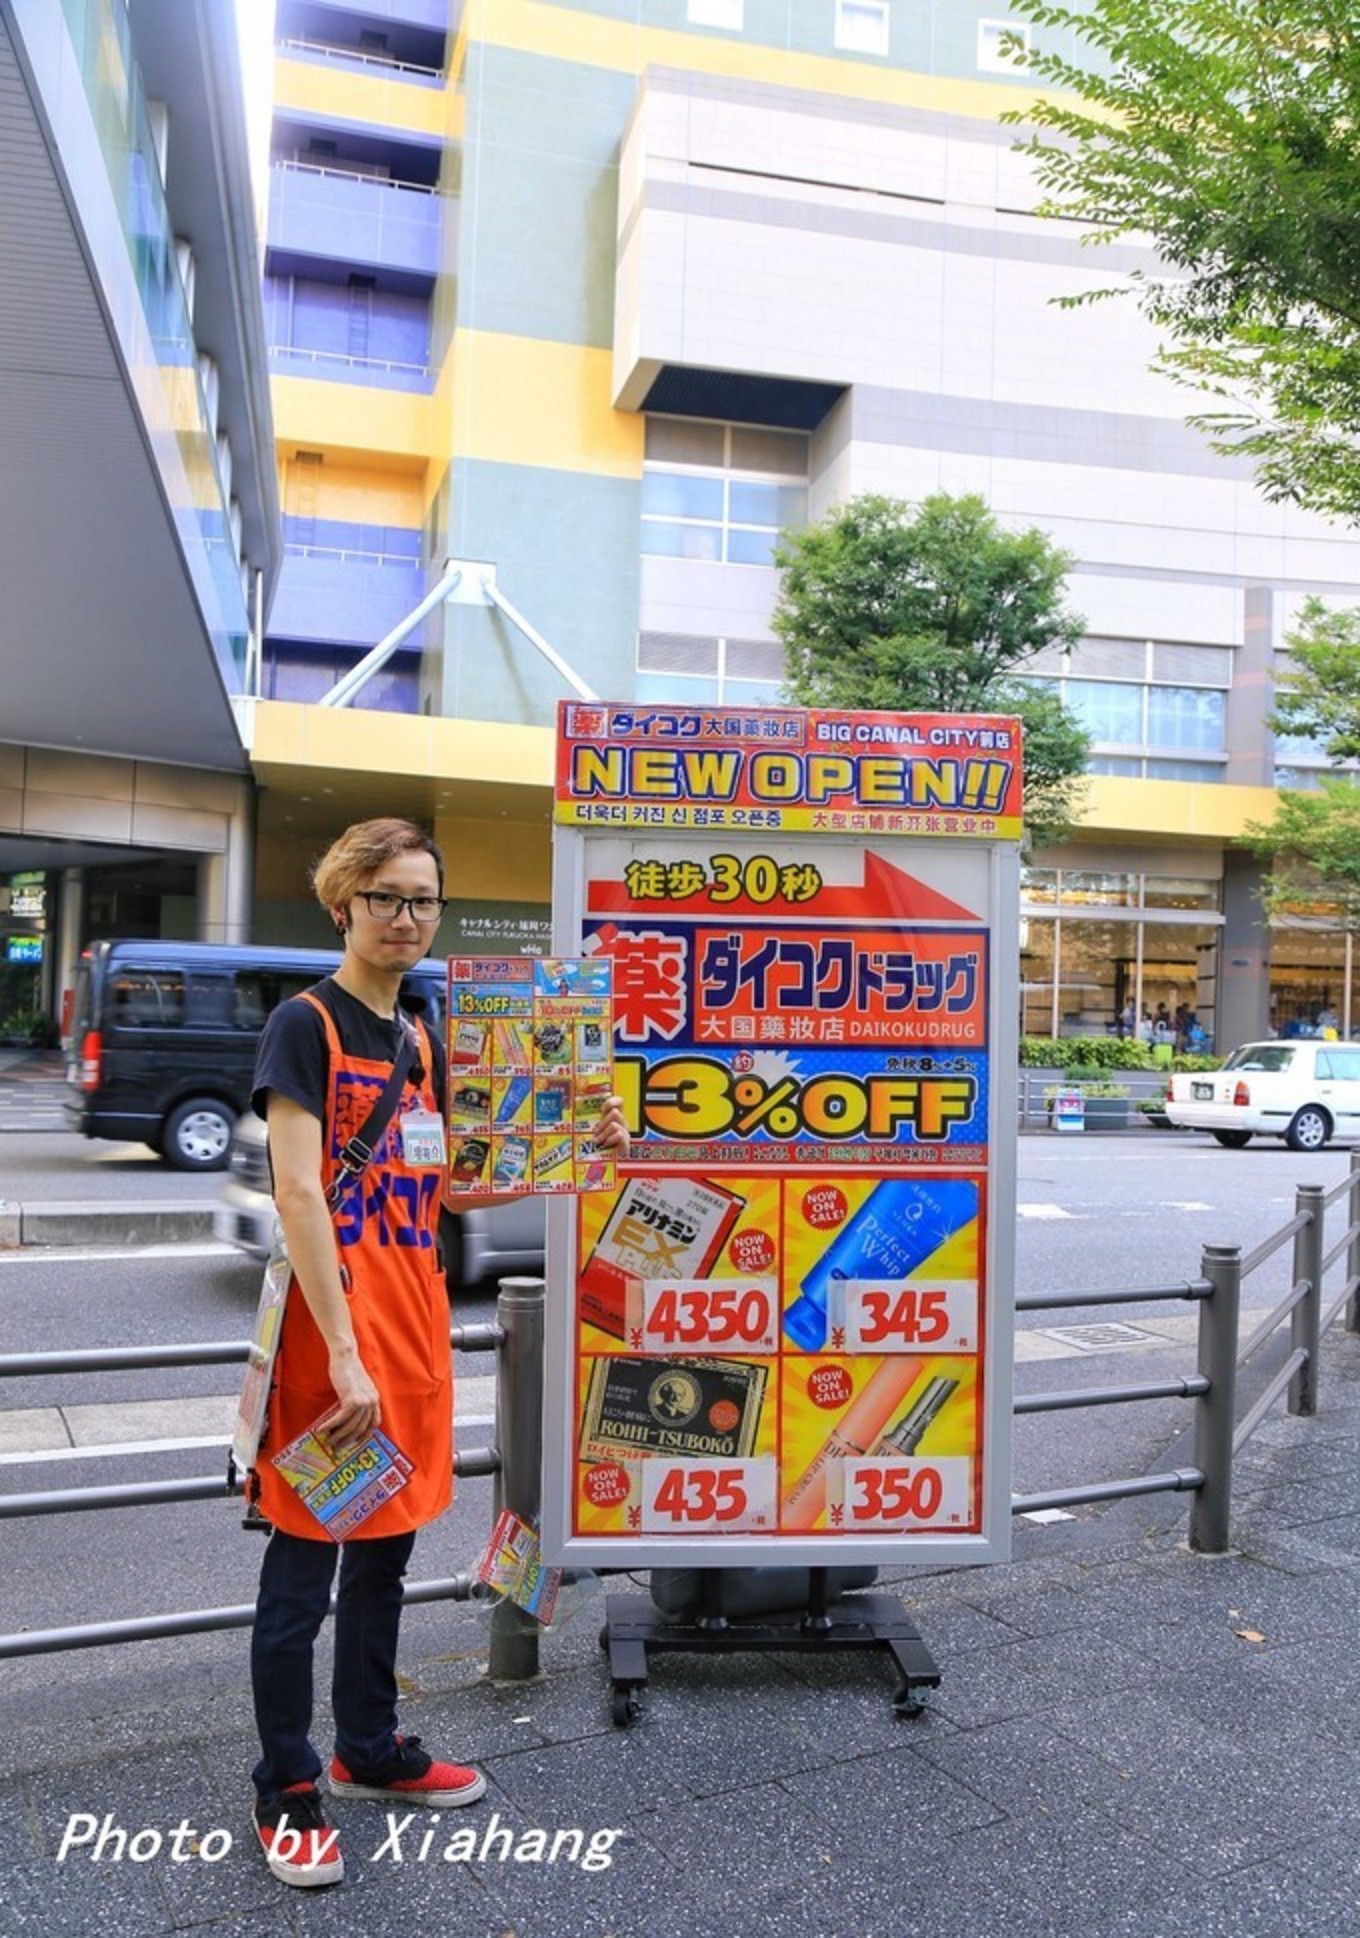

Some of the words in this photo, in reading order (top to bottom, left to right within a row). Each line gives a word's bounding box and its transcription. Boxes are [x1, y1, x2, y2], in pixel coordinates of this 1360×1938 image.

[612, 713, 701, 737] ダイコク
[816, 722, 851, 742] BIG
[856, 725, 925, 745] CANAL
[573, 746, 742, 800] NEW
[751, 749, 1010, 811] OPEN!!
[576, 804, 627, 822] 더욱더
[633, 805, 665, 823] 커진
[672, 806, 687, 823] 신
[693, 807, 725, 825] 점포
[731, 809, 783, 827] 오픈중
[625, 854, 822, 902] 徒歩30秒
[700, 934, 979, 1013] ダイコクドラッグ
[850, 1020, 976, 1040] DAIKOKUDRUG
[612, 1057, 974, 1139] 13%OFF
[807, 1190, 839, 1205] NOW
[812, 1200, 836, 1212] ON
[625, 1199, 700, 1245] アリナミン
[809, 1209, 845, 1225] SALE!
[611, 1215, 691, 1269] EX
[734, 1233, 765, 1248] NOW
[739, 1245, 763, 1257] ON
[737, 1254, 773, 1271] SALE!
[647, 1289, 771, 1344] 4350
[859, 1290, 950, 1343] 345
[811, 1370, 844, 1385] NOW
[817, 1380, 840, 1392] ON
[814, 1389, 850, 1405] SALE!
[588, 1467, 620, 1483] NOW
[593, 1479, 617, 1491] ON
[590, 1487, 628, 1503] SALE!
[653, 1468, 748, 1523] 435
[852, 1466, 943, 1521] 350
